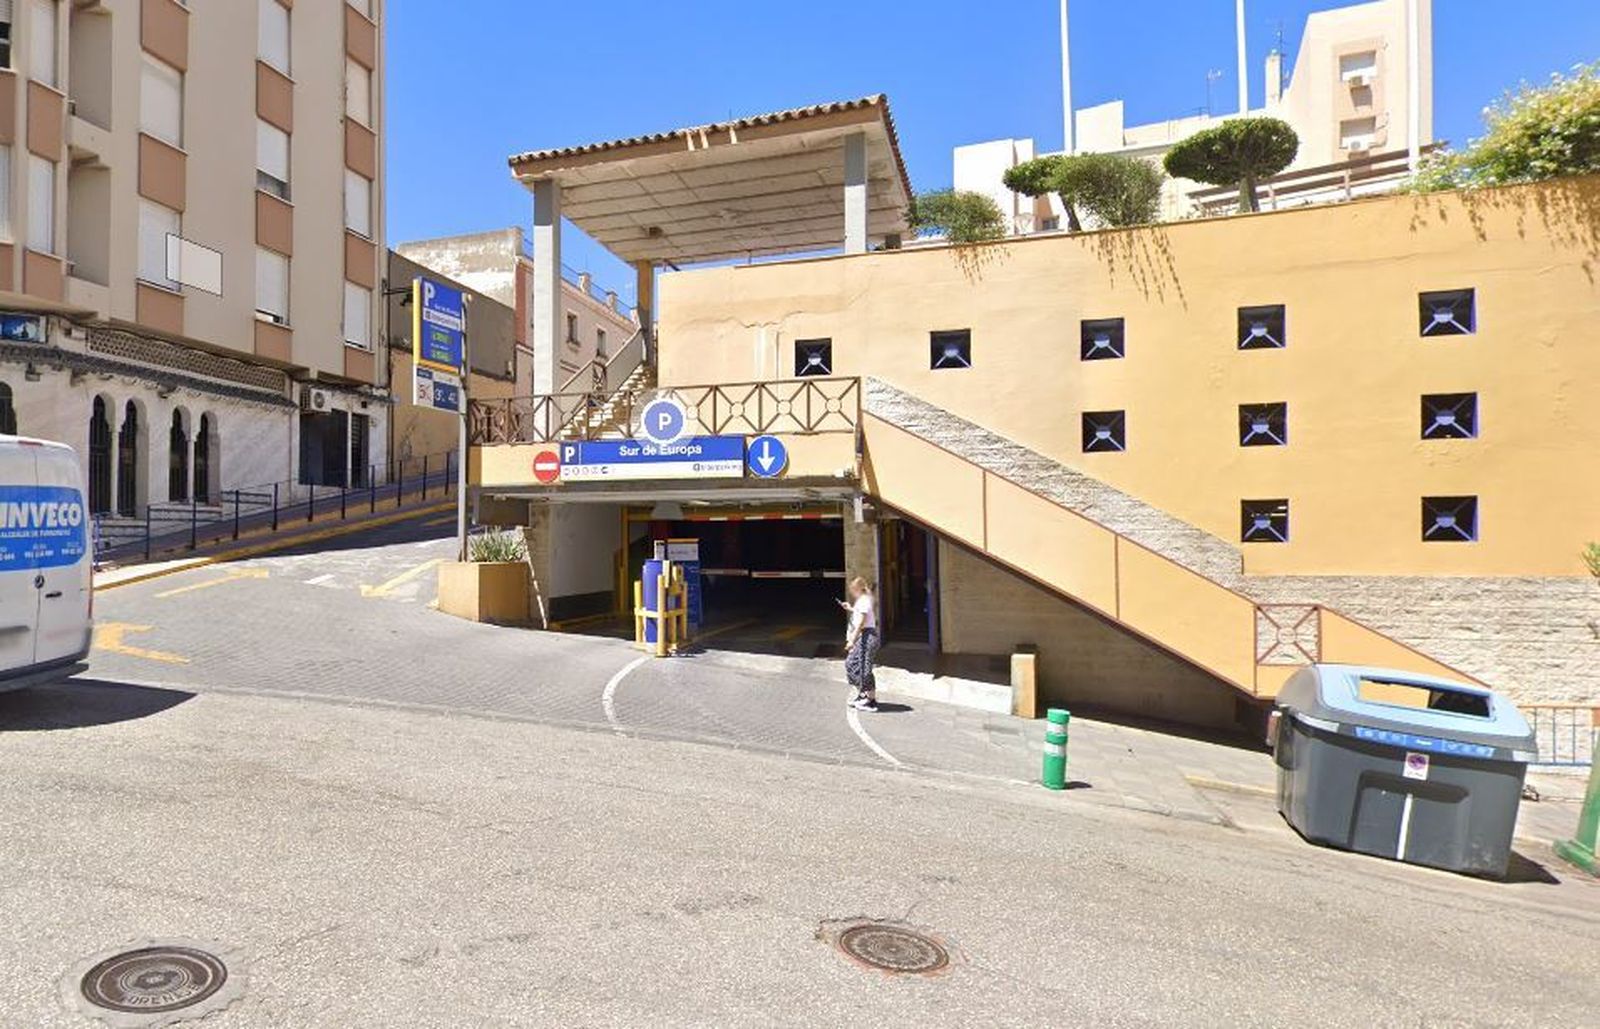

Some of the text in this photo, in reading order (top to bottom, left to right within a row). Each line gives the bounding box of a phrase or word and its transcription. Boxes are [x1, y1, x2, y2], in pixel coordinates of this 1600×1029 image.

[424, 281, 435, 307] P
[564, 446, 576, 463] P
[619, 444, 703, 457] Sur de Europa
